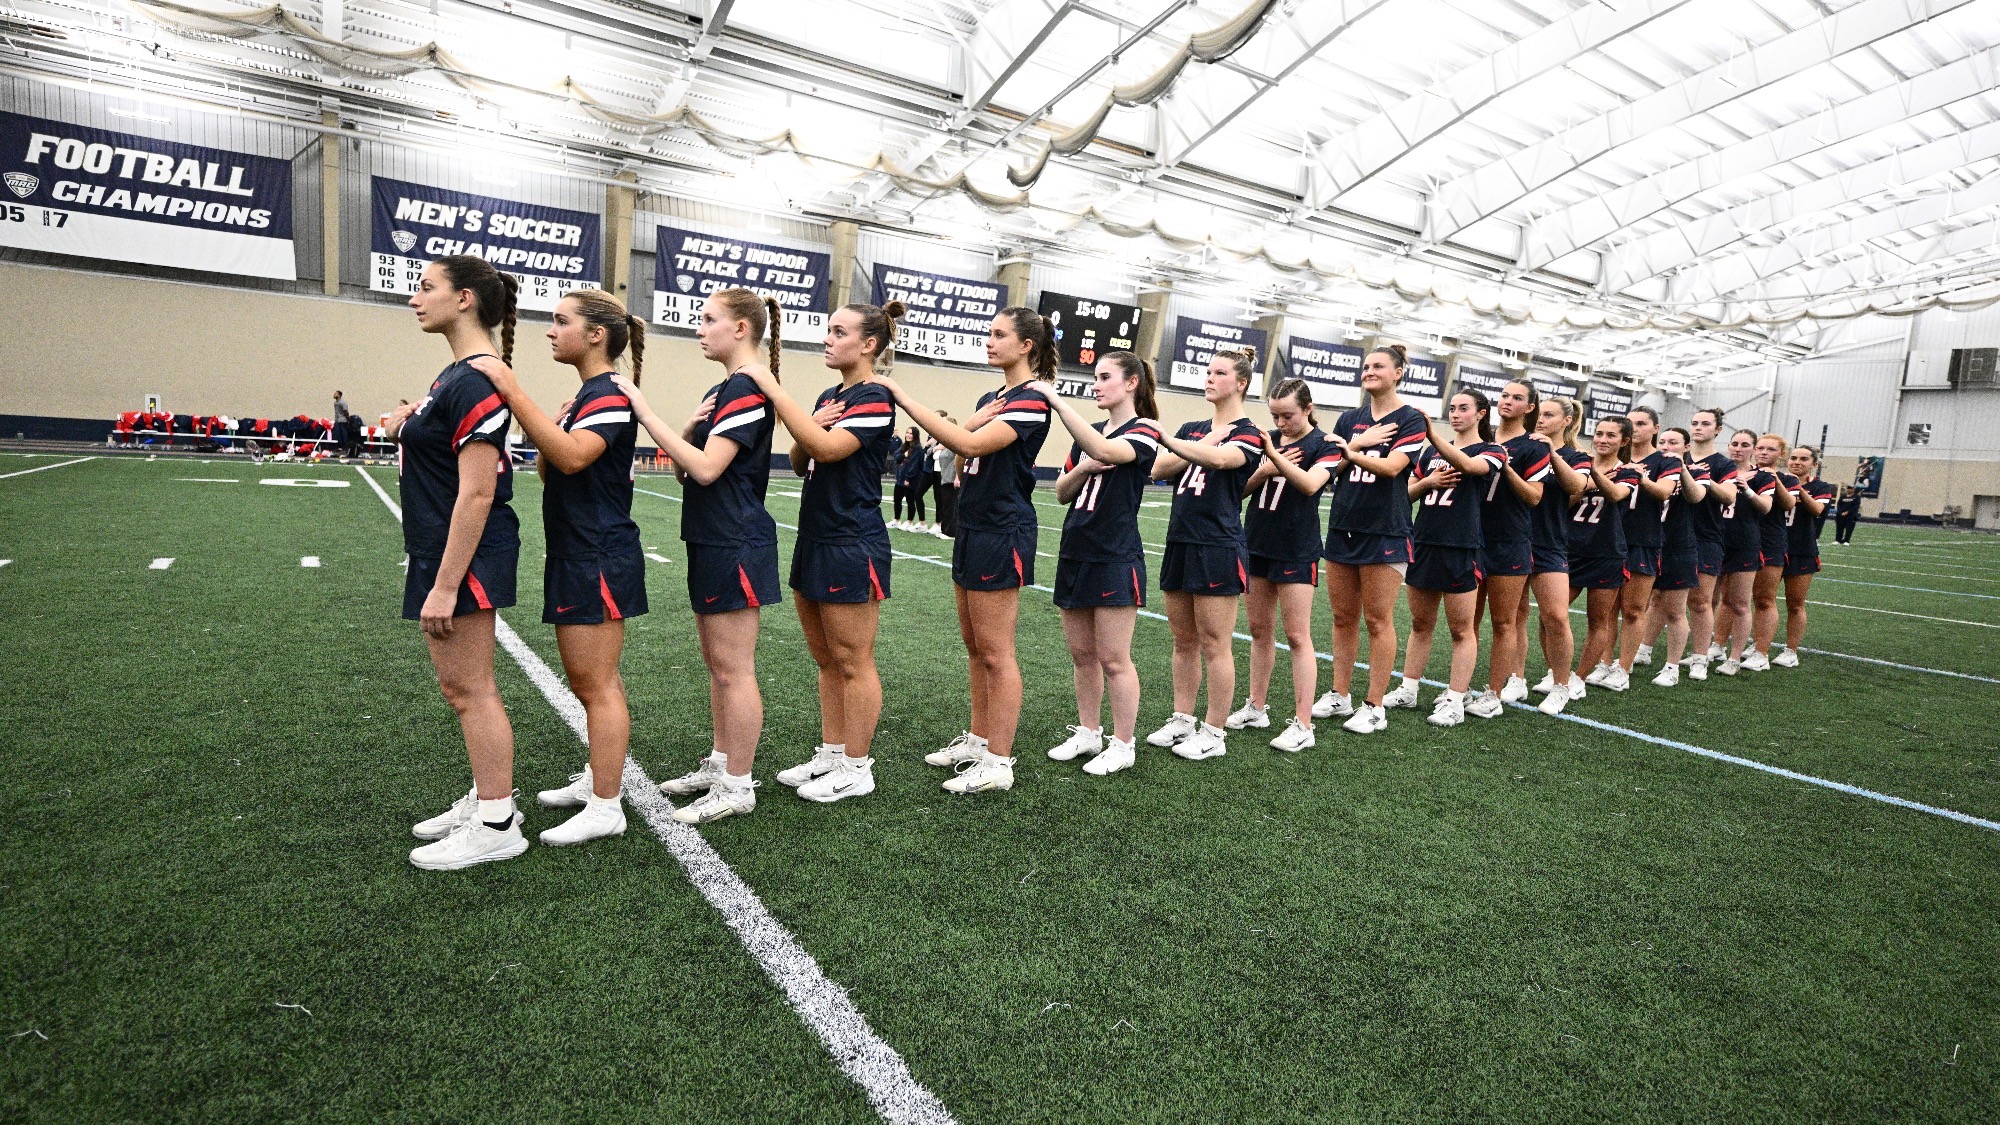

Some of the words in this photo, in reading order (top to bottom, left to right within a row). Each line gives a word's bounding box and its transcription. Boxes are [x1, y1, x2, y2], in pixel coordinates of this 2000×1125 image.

[24, 132, 254, 197] FOOTBALL
[52, 180, 272, 229] CHAMPIONS
[394, 197, 483, 232] MEN'S
[487, 213, 582, 247] SOCCER
[425, 236, 584, 274] CHAMPIONS
[681, 236, 743, 261] MEN'S
[745, 247, 809, 271] INDOOR
[379, 255, 395, 265] 93
[407, 260, 422, 270] 95
[534, 277, 548, 287] 02
[558, 280, 571, 289] 04
[379, 267, 395, 277] 06
[407, 271, 422, 281] 07
[535, 288, 548, 297] 12
[381, 279, 395, 289] 15
[408, 283, 420, 293] 16
[675, 254, 741, 279] TRACK
[745, 267, 760, 281] &
[764, 268, 816, 289] FIELD
[884, 271, 933, 291] MEN'S
[934, 279, 999, 301] OUTDOOR
[662, 310, 680, 323] 20
[666, 296, 677, 308] 11
[690, 299, 704, 311] 12
[786, 312, 799, 324] 17
[808, 314, 821, 327] 19
[885, 288, 939, 309] TRACK
[956, 300, 997, 316] FIELD
[1075, 301, 1111, 320] 15:00
[904, 309, 992, 333] CHAMPIONS
[914, 342, 928, 354] 24
[934, 345, 947, 356] 25
[917, 330, 926, 341] 11
[935, 333, 946, 343] 12
[953, 335, 964, 345] 13
[972, 336, 982, 347] 16
[1056, 380, 1082, 396] EAT
[1303, 365, 1355, 382] CHAMPIONS
